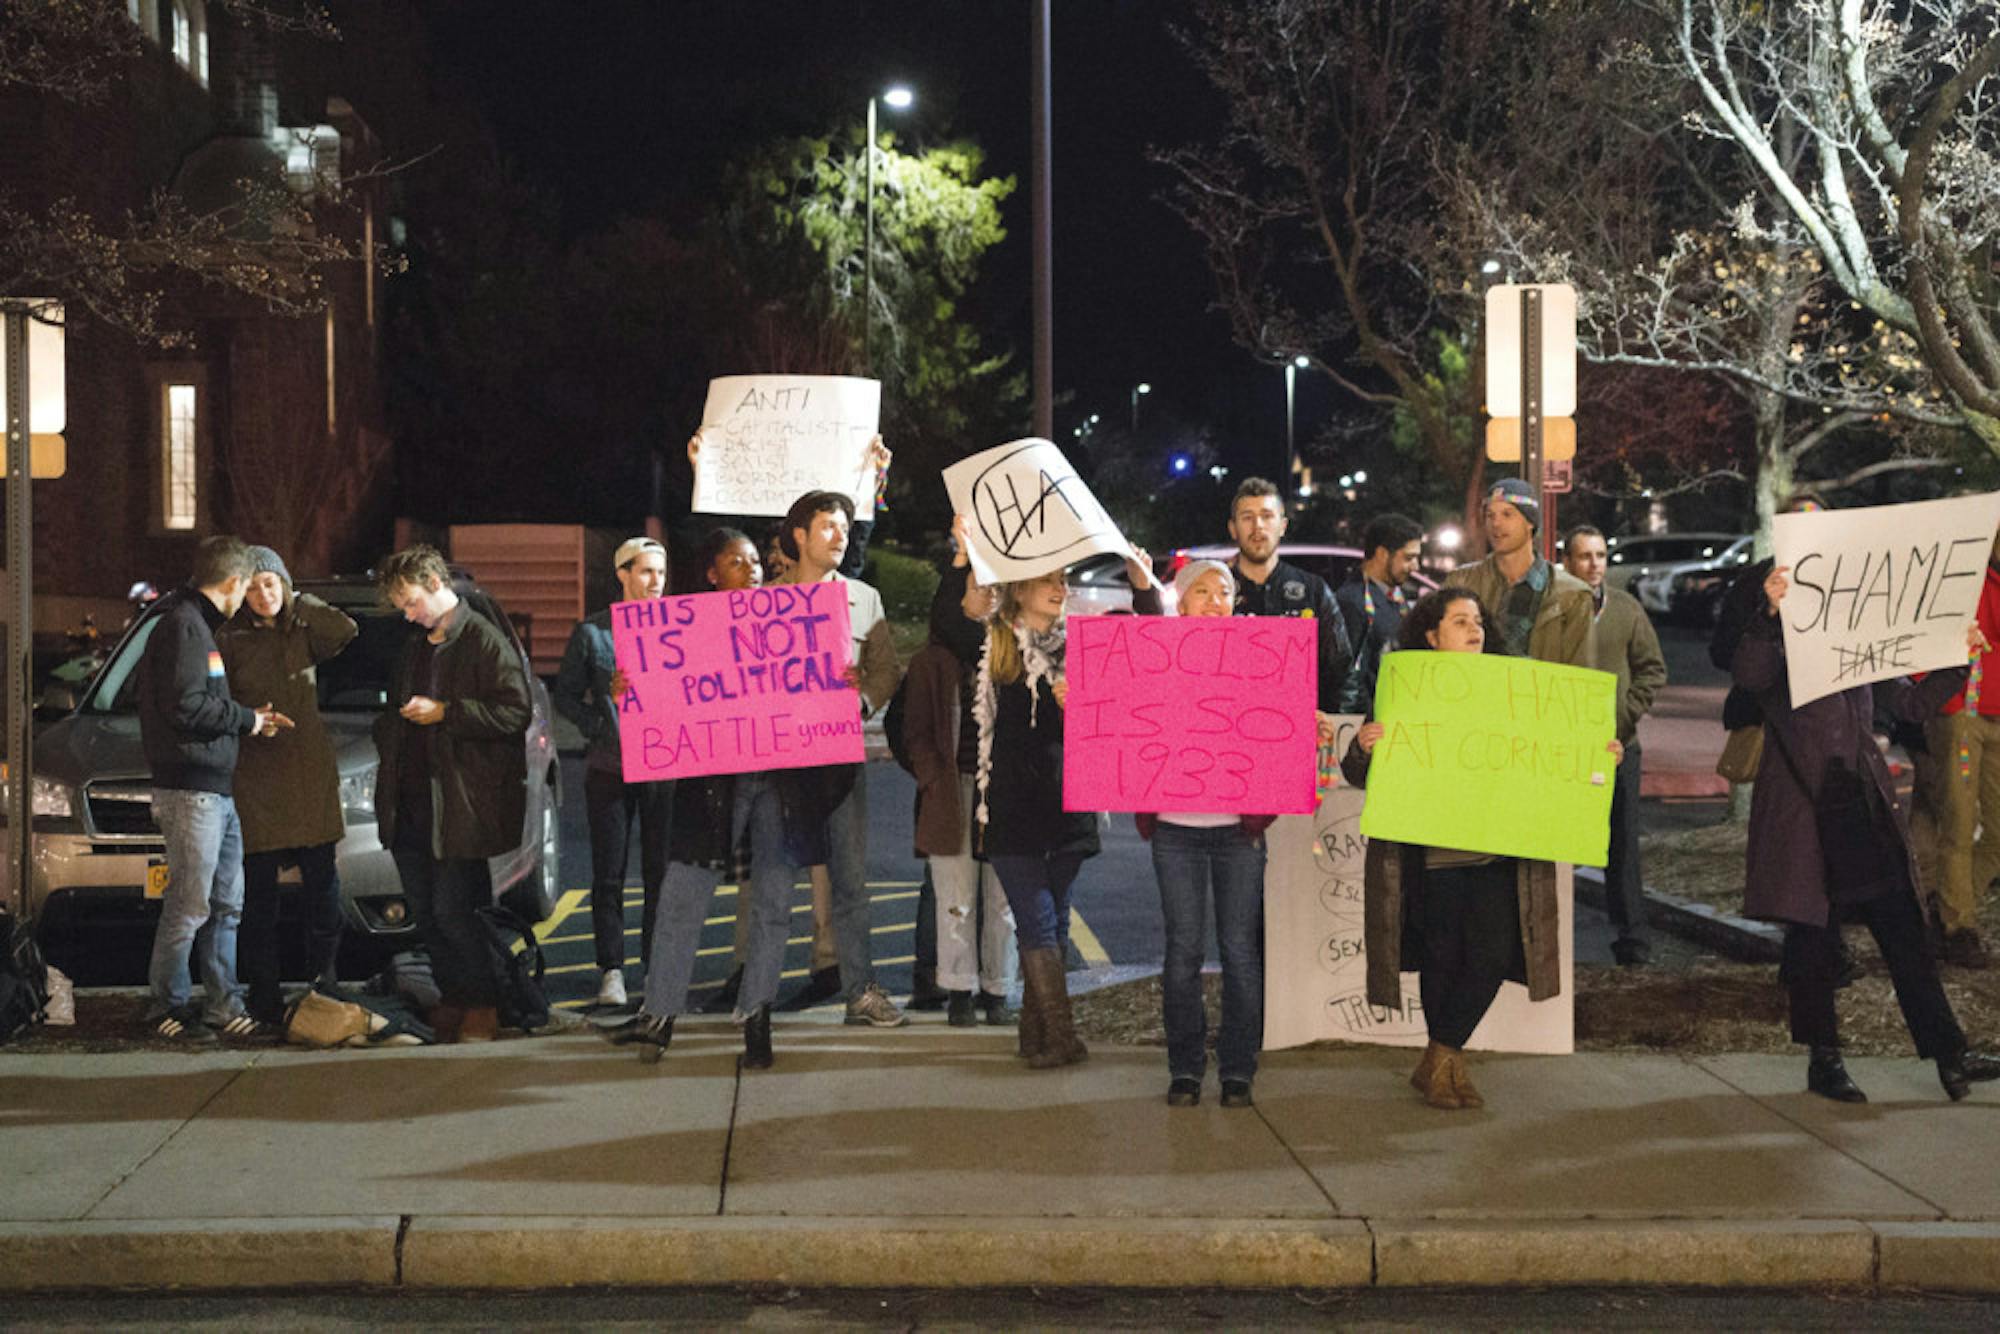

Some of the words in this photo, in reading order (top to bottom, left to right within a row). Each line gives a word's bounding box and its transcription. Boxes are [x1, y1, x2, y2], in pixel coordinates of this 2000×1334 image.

[736, 387, 810, 413] ANTI
[984, 469, 1082, 547] HA
[616, 598, 695, 629] THIS
[729, 584, 821, 619] BODY
[1792, 537, 1988, 633] SHAME
[636, 629, 685, 672] IS
[730, 614, 830, 663] NOT
[1078, 618, 1312, 690] FASCISM
[622, 685, 643, 713] A
[682, 652, 847, 705] POLITICAL
[1390, 660, 1472, 702] NO
[1507, 667, 1609, 731] HATE
[643, 713, 792, 770] BATTLE
[799, 710, 863, 748] ground
[1080, 699, 1165, 741] IS
[1185, 697, 1295, 742] SO
[1385, 720, 1441, 769] AT
[1117, 742, 1255, 801] 1933
[1323, 833, 1368, 862] RAC
[1329, 938, 1364, 962] SEX
